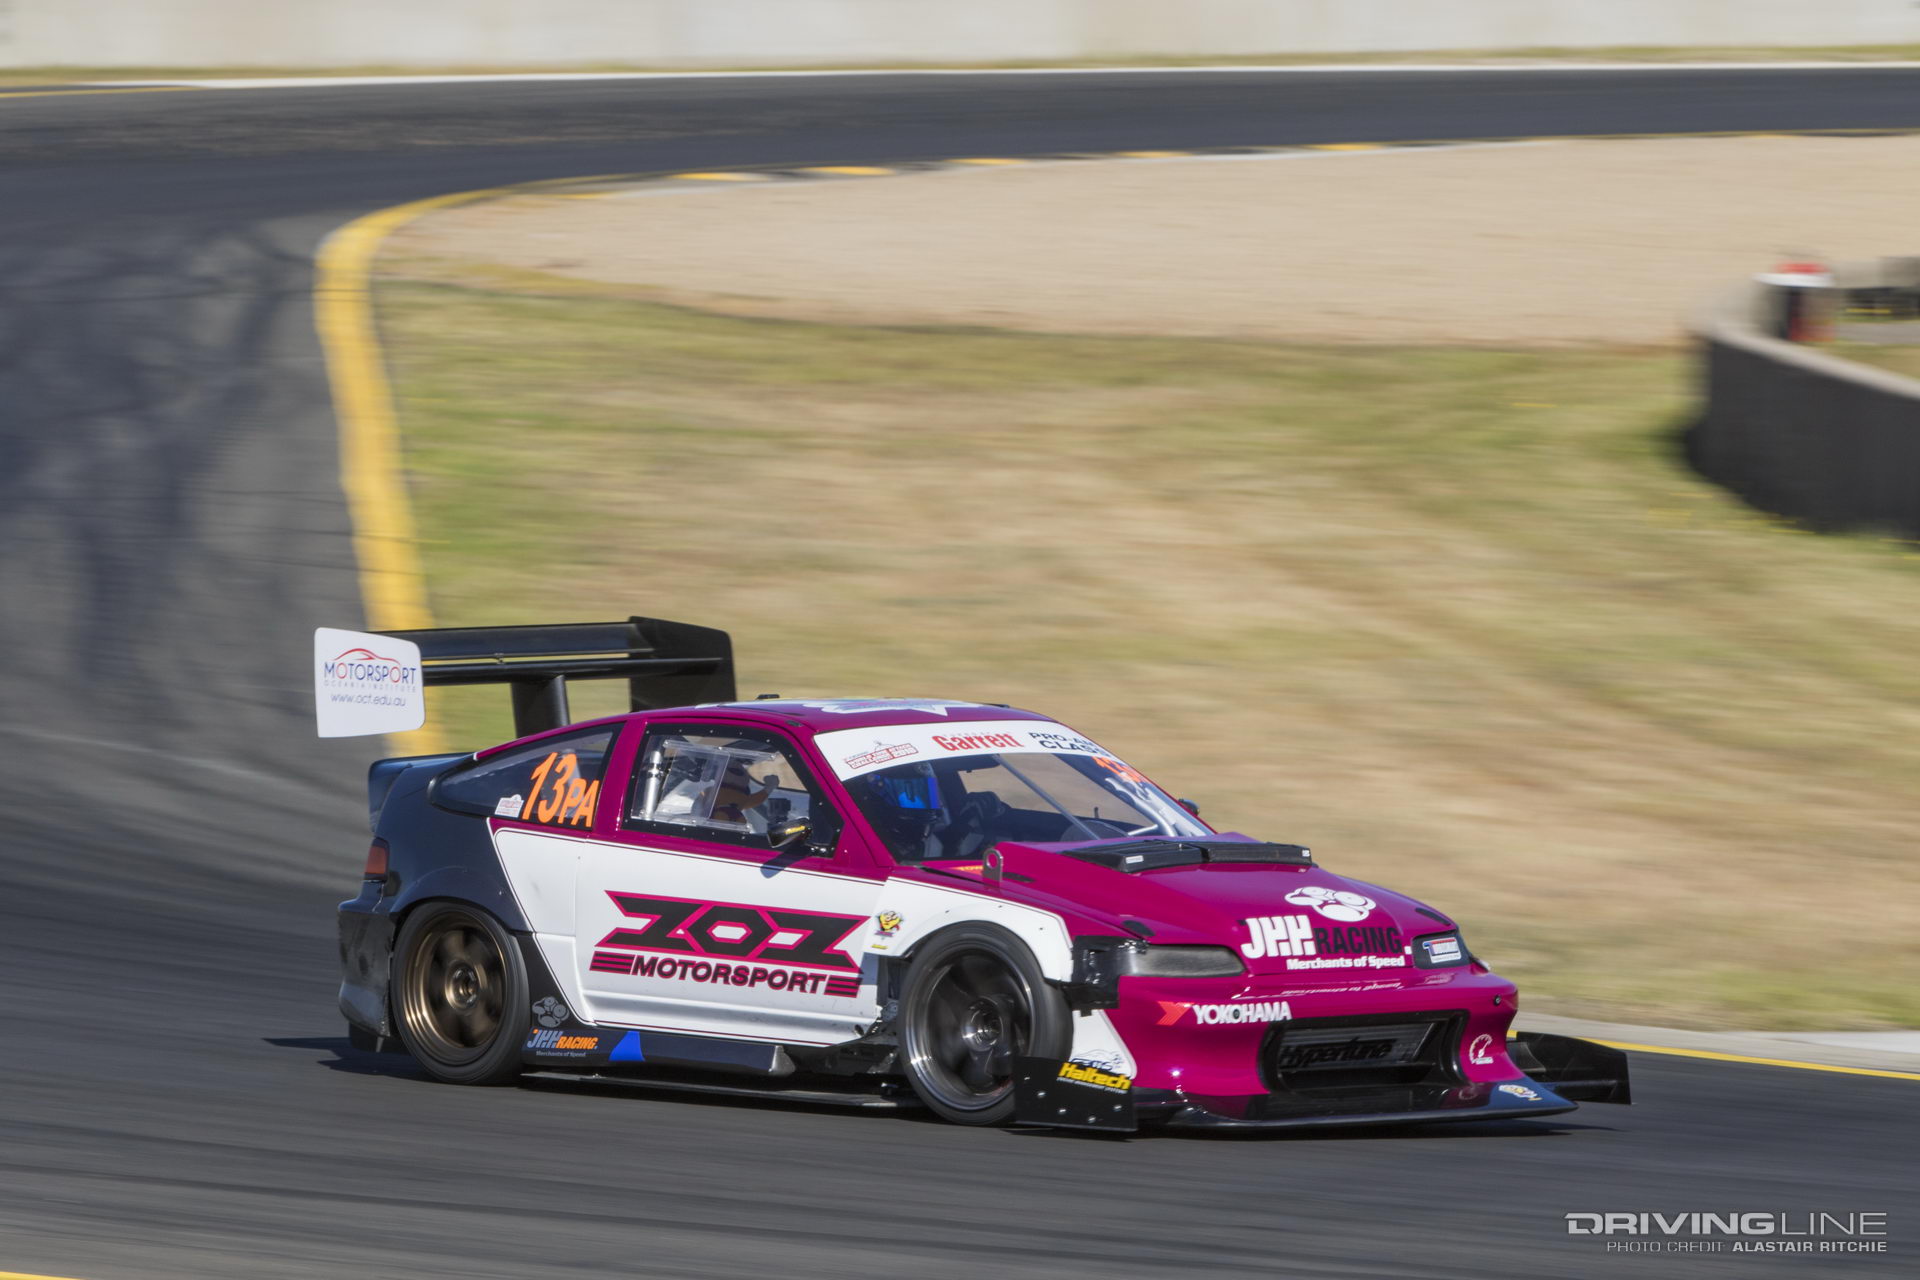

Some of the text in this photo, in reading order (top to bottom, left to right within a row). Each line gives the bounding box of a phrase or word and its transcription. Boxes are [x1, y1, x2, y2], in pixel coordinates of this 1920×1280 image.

[324, 662, 416, 684] MOTORSPORT
[330, 694, 406, 707] www.oct.edu.au
[932, 733, 1024, 751] Garrett
[1286, 955, 1406, 970] Merchants of Speed
[631, 955, 827, 994] MOTORSPORT
[1192, 1001, 1293, 1024] YOKOHAMA
[1058, 1062, 1131, 1090] Haltech
